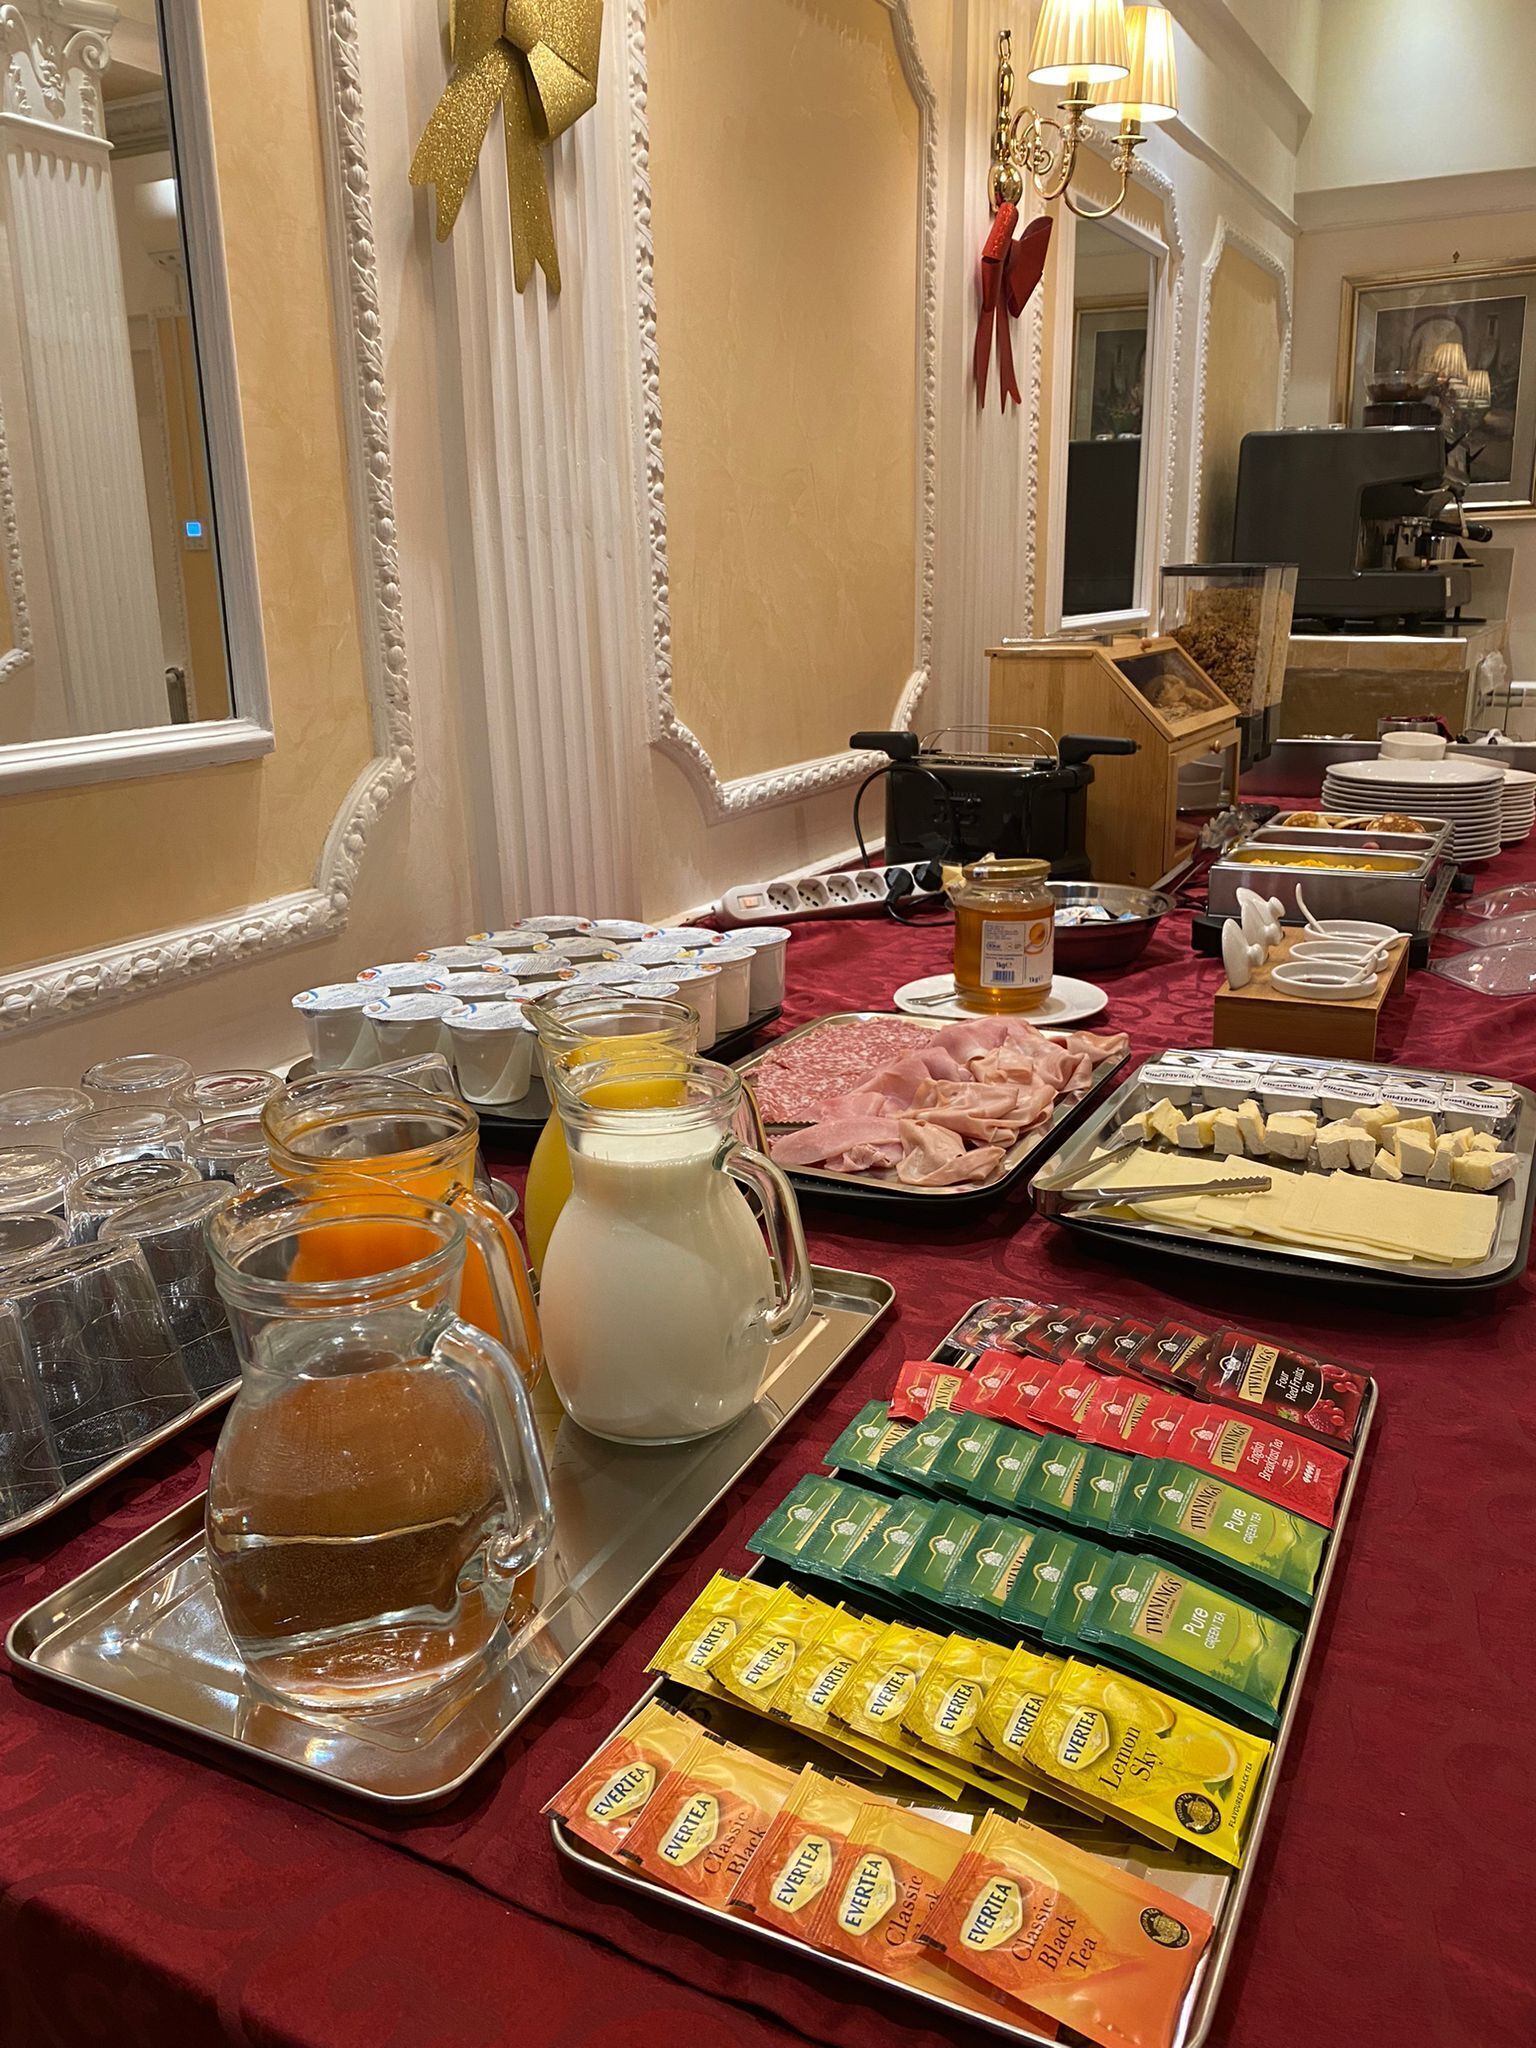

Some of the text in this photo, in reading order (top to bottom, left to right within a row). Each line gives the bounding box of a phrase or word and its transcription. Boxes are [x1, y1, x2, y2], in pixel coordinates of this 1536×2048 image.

[1382, 1092, 1436, 1106] PHILADELPHIA
[1248, 1349, 1276, 1396] TWININGS
[1275, 1370, 1290, 1388] Four
[1285, 1367, 1306, 1402] Red Fruits
[1301, 1382, 1315, 1394] Tea
[1222, 1424, 1248, 1465] TWININGS
[1247, 1442, 1265, 1465] English
[1258, 1438, 1284, 1482] Breakfast Tea
[1191, 1484, 1222, 1530] TWININGS
[1224, 1508, 1247, 1533] Pure
[1243, 1512, 1262, 1544] GREEN TEA
[1146, 1578, 1182, 1634] TWININGS
[1182, 1607, 1208, 1637] Pure
[690, 1621, 730, 1666] EVERTEA
[1204, 1612, 1226, 1649] GREEN TEA
[746, 1640, 788, 1684] EVERTEA
[812, 1660, 852, 1705] EVERTEA
[870, 1671, 908, 1716] EVERTEA
[941, 1684, 974, 1730] EVERTEA
[1009, 1697, 1044, 1746] EVERTEA
[1064, 1711, 1098, 1764] EVERTEA
[1098, 1726, 1141, 1792] Lemon
[1130, 1746, 1164, 1782] Sky
[594, 1768, 649, 1818] EVERTEA
[1228, 1791, 1244, 1828] FLAVOURED
[1238, 1774, 1250, 1793] BLACK
[664, 1798, 711, 1860] EVERTEA
[702, 1812, 749, 1876] Classic
[776, 1842, 823, 1905] EVERTEA
[844, 1860, 882, 1927] EVERTEA
[886, 1876, 923, 1946] Classic
[967, 1884, 1011, 1944] EVERTEA
[1011, 1898, 1056, 1962] Classic
[1038, 1916, 1077, 1972] Black
[1067, 1937, 1097, 1972] Tea
